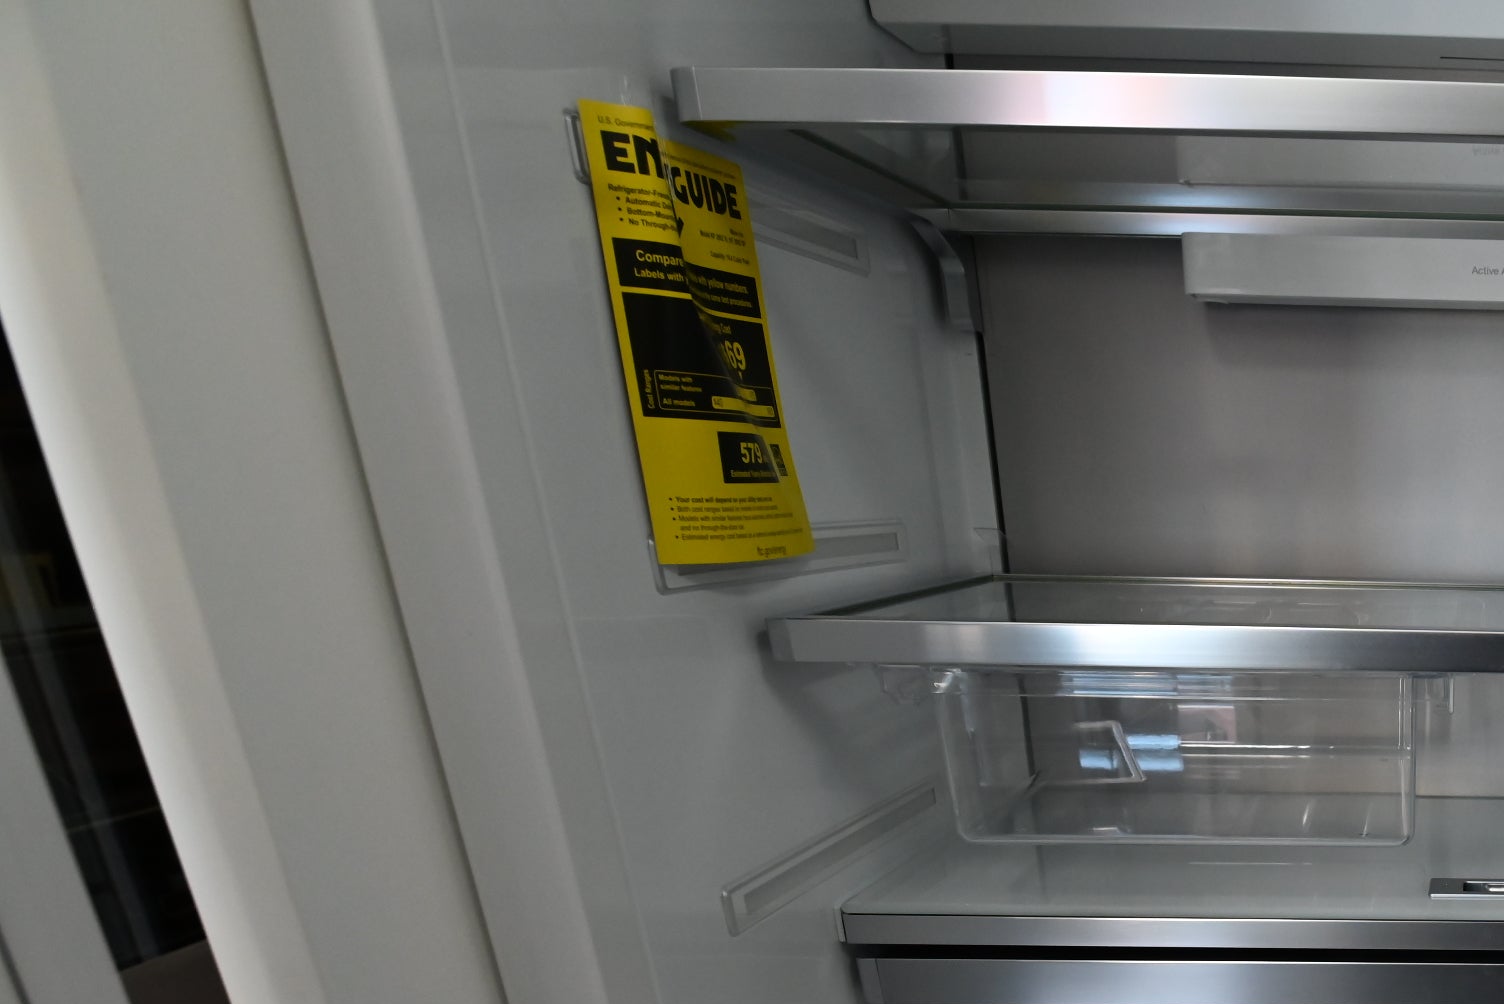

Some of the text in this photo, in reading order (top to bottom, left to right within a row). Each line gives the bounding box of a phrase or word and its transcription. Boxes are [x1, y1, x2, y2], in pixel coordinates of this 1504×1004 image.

[671, 167, 742, 219] GUIDE
[635, 250, 685, 268] Compare
[634, 267, 666, 280] Labels
[667, 271, 684, 282] with
[1471, 265, 1499, 276] Active
[720, 340, 746, 370] 69
[739, 442, 764, 464] 579
